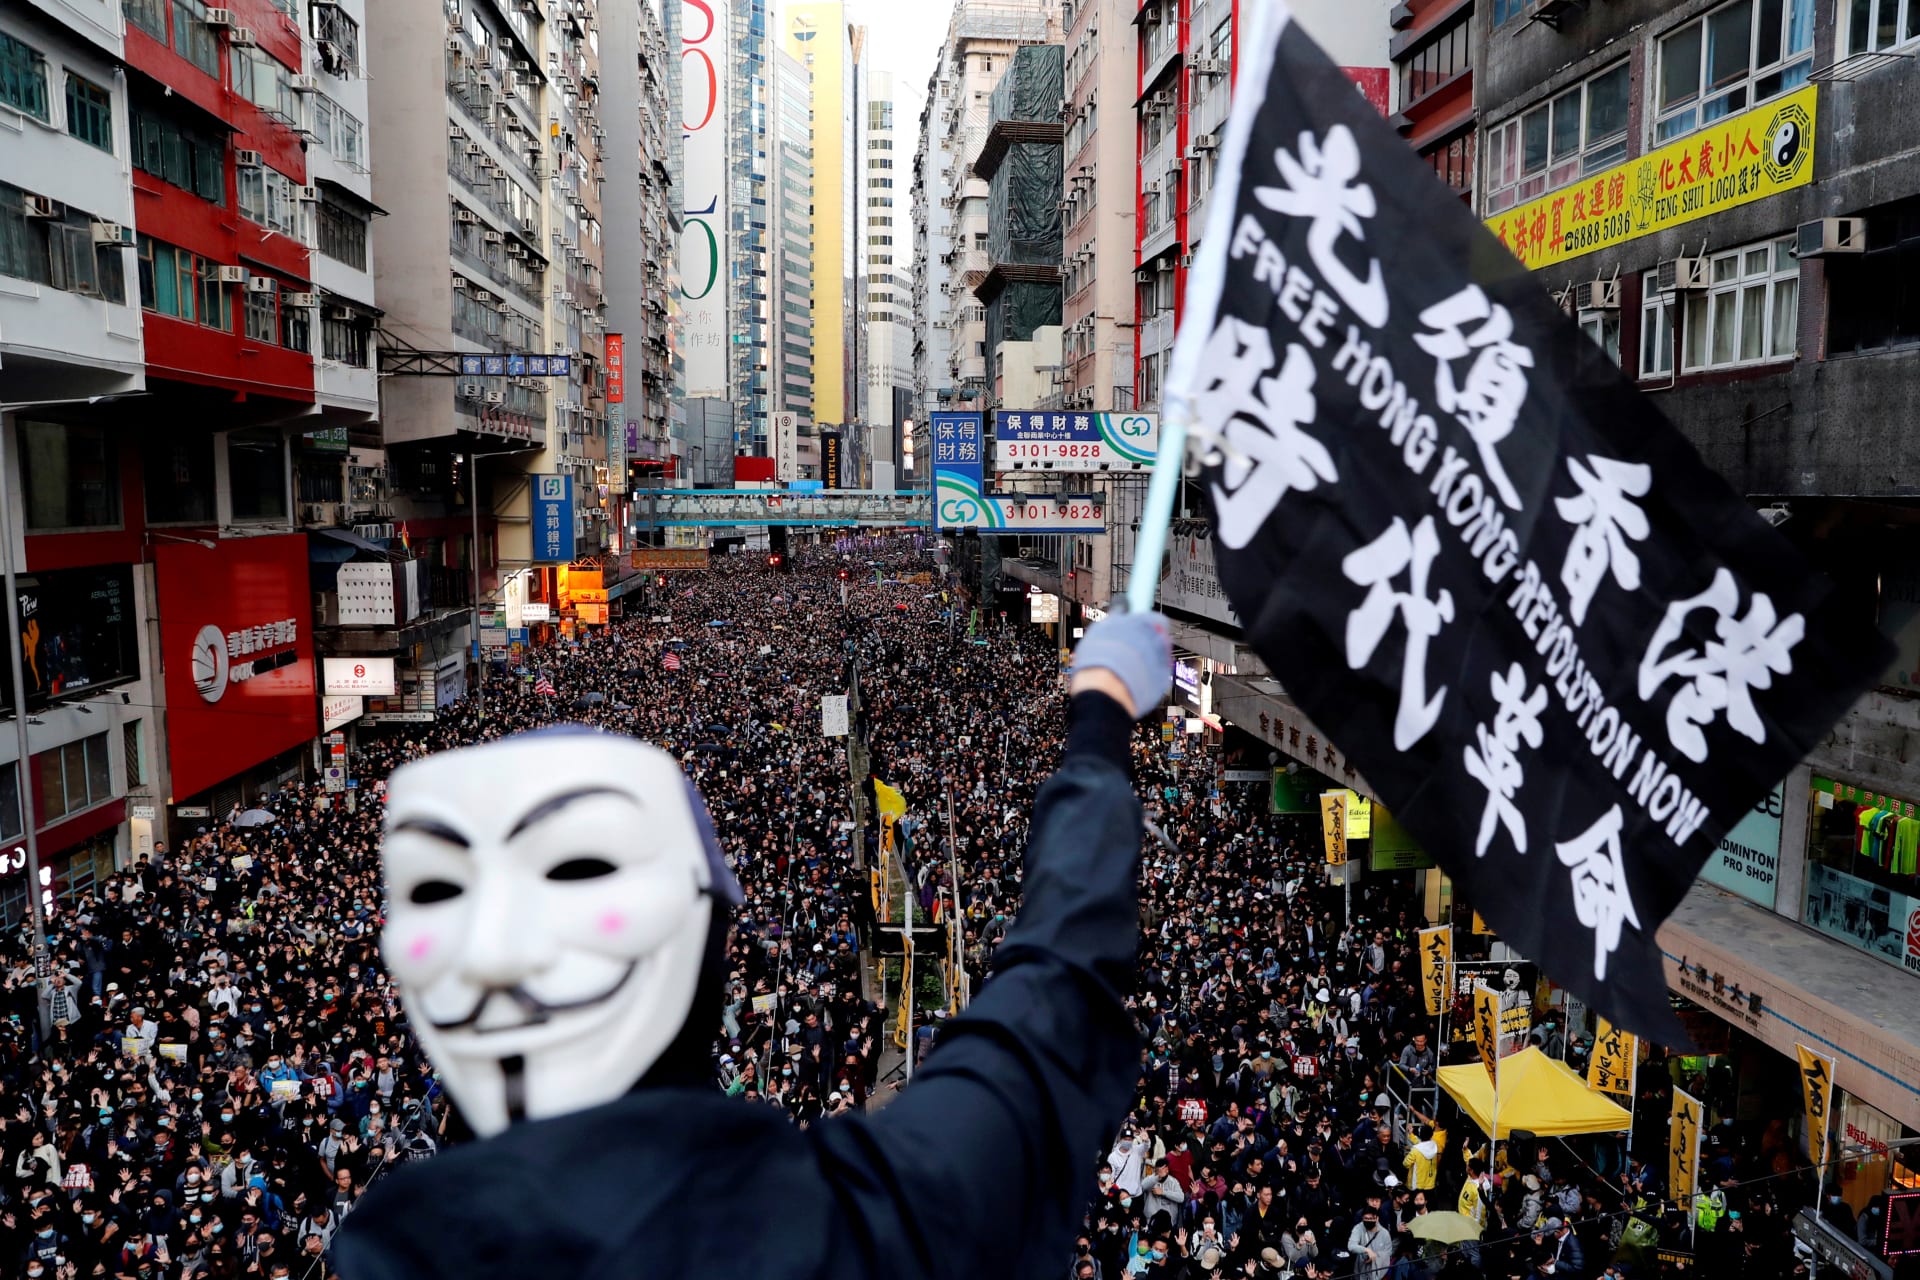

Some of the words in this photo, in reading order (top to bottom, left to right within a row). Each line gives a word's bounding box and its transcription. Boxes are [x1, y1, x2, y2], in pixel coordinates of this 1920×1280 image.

[1659, 128, 1759, 193] 化太歲小人
[1571, 173, 1625, 223] 改運館
[1656, 194, 1678, 222] FENG
[1682, 185, 1705, 213] SHUI
[1710, 174, 1736, 205] LOGO
[1738, 162, 1761, 197] 設計
[1574, 221, 1600, 250] 6888
[1603, 210, 1630, 241] 5036
[937, 421, 977, 440] 保得
[1007, 414, 1089, 430] 保得財務
[937, 442, 977, 461] 財務
[1008, 444, 1100, 458] 3101-9828
[1006, 505, 1102, 520] 3101-9828
[546, 503, 560, 557] 富邦銀行
[1231, 214, 1340, 347] FREE
[1332, 325, 1438, 473] HONG
[1429, 447, 1520, 583] KONG
[1507, 560, 1643, 781] REVOLUTION
[1632, 751, 1711, 848] NOW
[1723, 855, 1743, 872] PRO
[1746, 866, 1774, 884] SHOP
